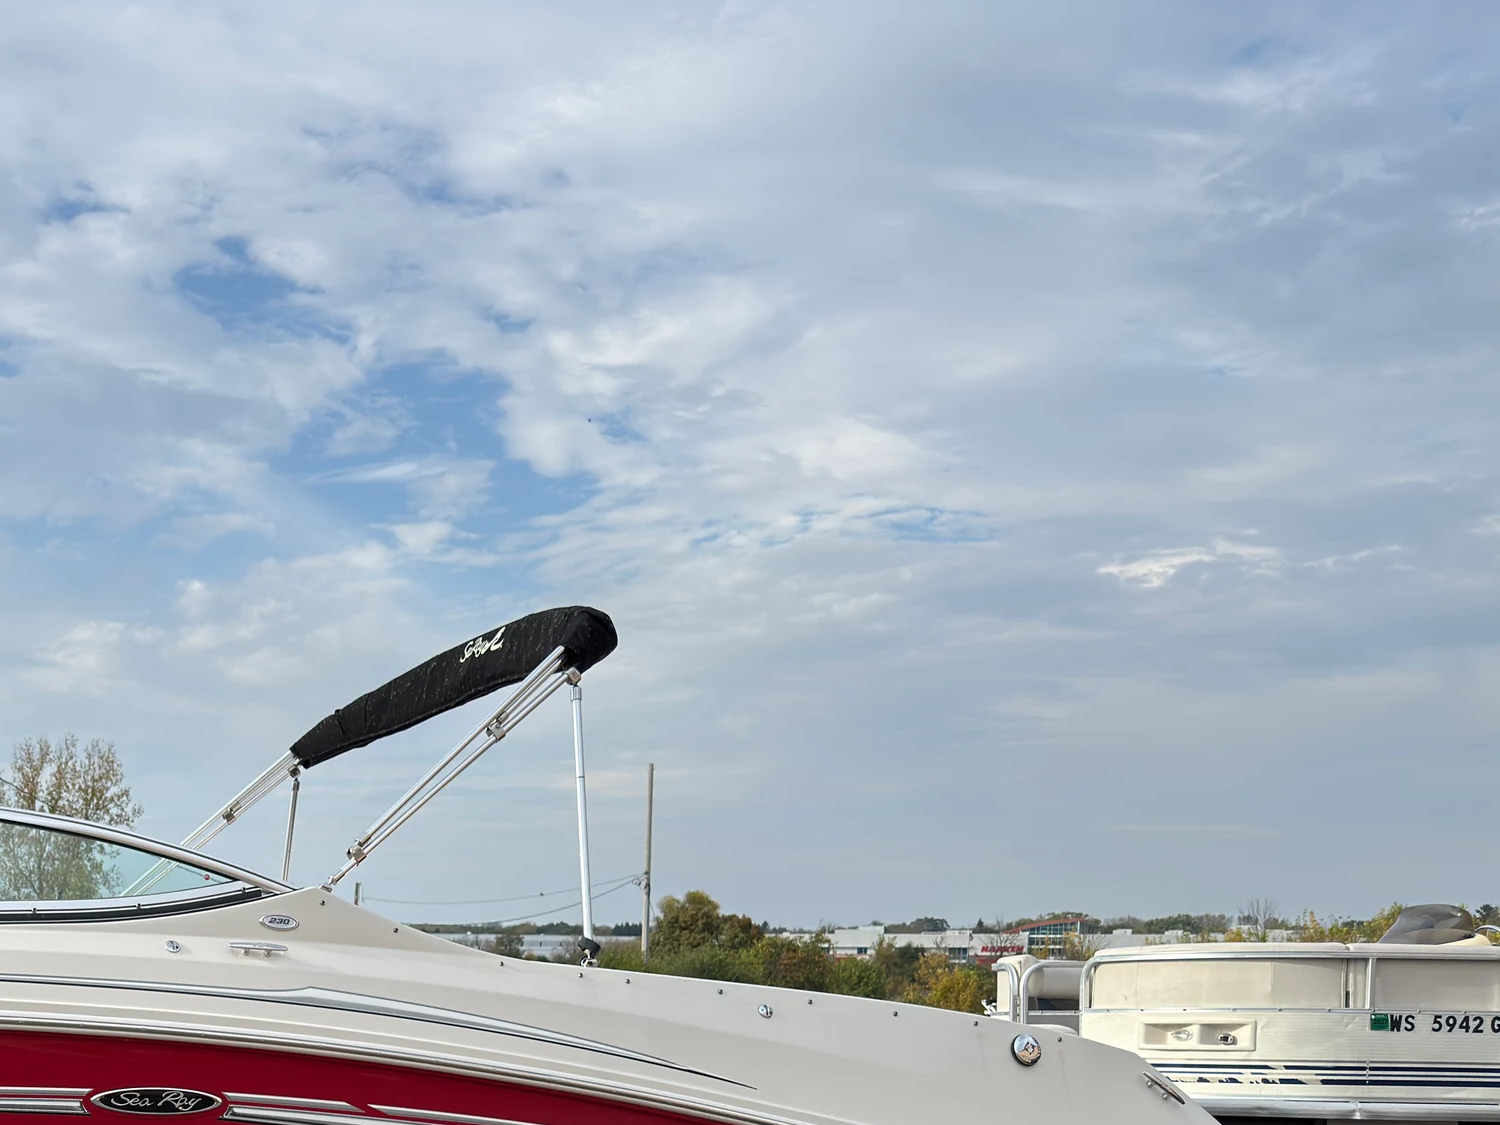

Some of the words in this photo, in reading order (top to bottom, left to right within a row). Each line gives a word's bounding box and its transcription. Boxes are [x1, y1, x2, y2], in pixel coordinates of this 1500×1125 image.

[269, 917, 290, 925] 230
[1390, 1014, 1415, 1032] WS
[1431, 1014, 1484, 1033] 5942
[110, 1091, 154, 1107] Sea
[157, 1090, 202, 1111] Ray
